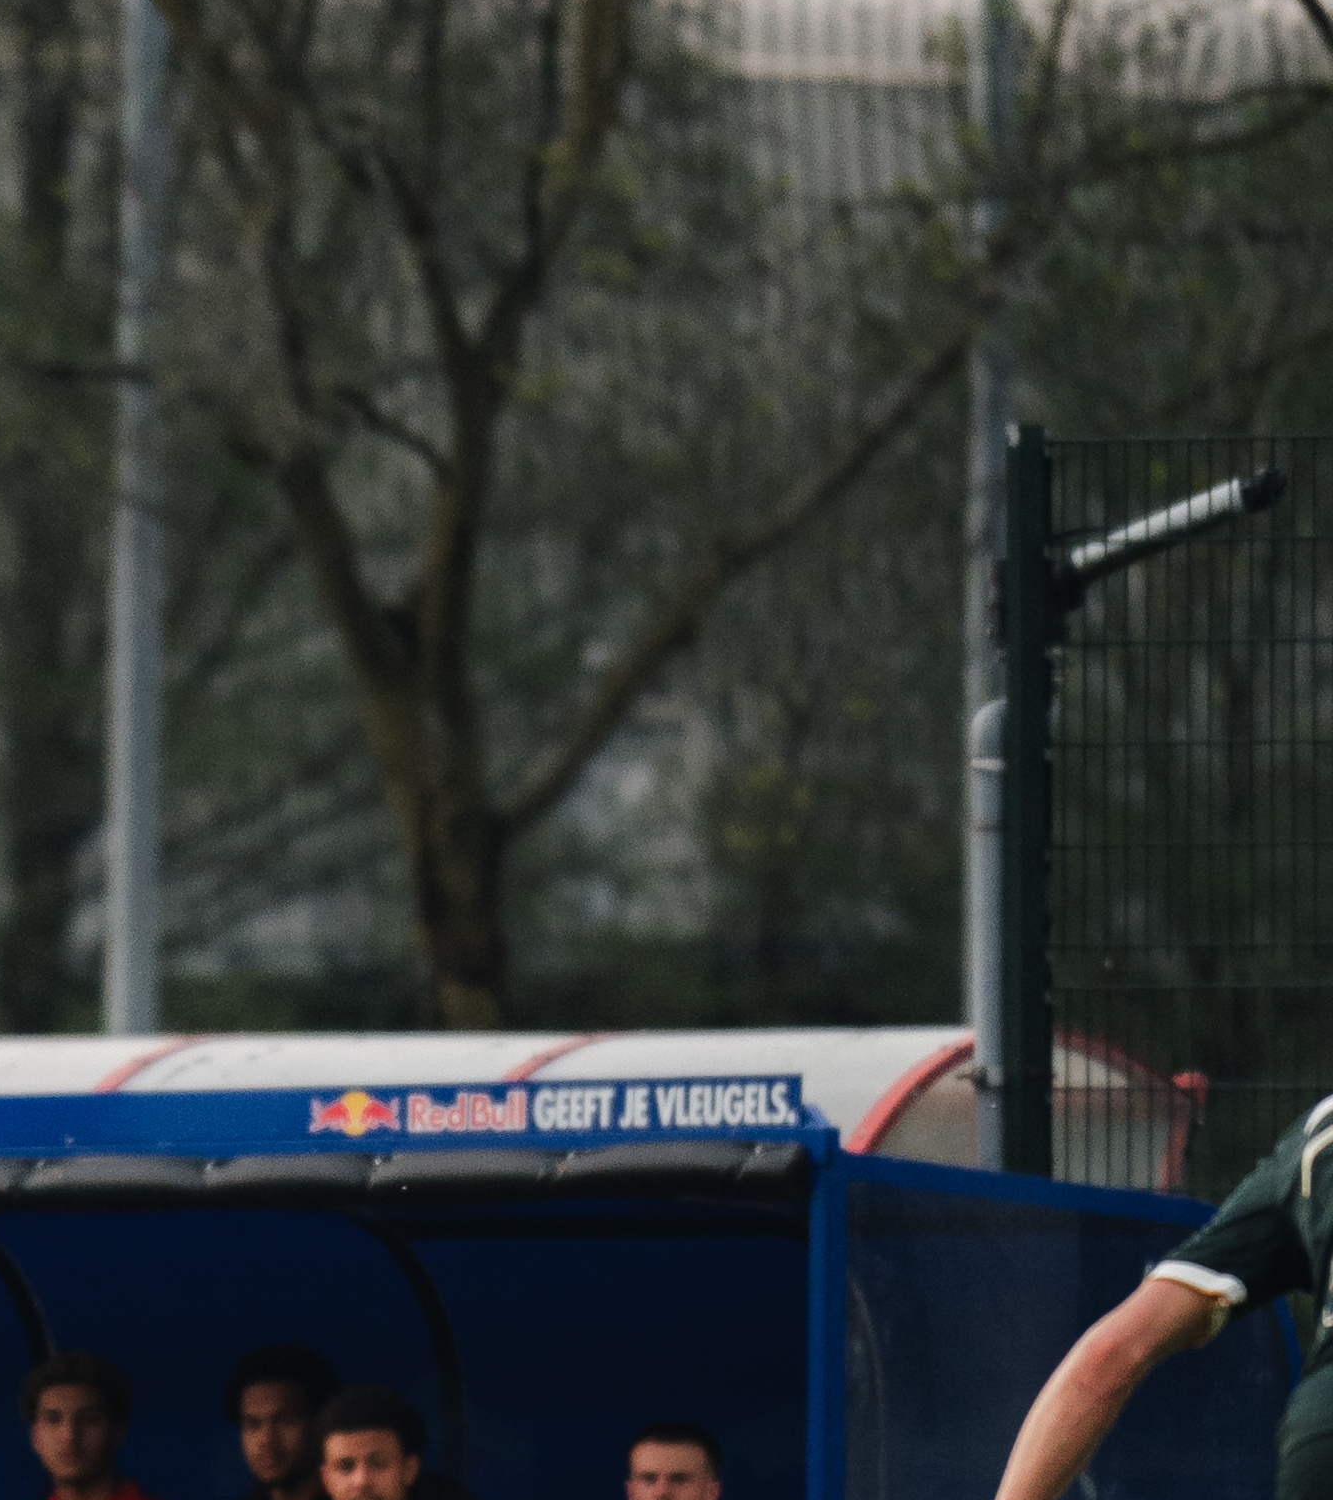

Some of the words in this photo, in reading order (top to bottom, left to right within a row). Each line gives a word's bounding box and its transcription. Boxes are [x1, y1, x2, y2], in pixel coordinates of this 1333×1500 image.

[536, 1087, 614, 1132] GEEFT
[620, 1084, 649, 1130] JE
[655, 1081, 797, 1129] VLEUGELS.
